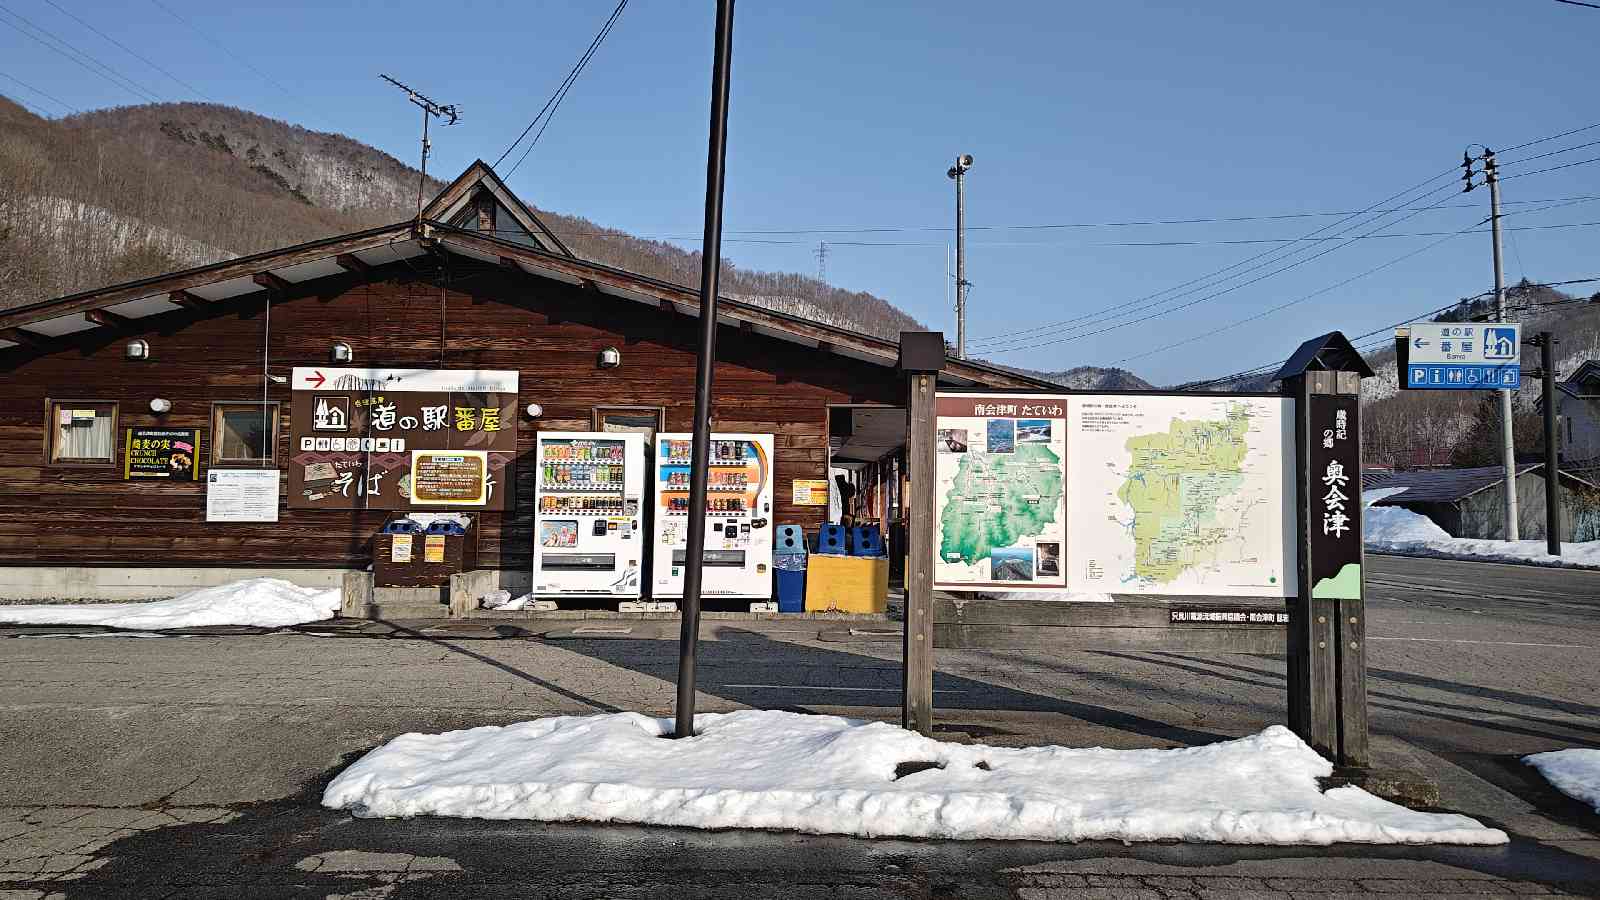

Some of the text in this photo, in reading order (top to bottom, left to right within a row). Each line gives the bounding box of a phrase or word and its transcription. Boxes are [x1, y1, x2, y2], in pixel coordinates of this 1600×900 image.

[1440, 327, 1475, 337] 道の駅
[1441, 341, 1473, 353] 番屋
[974, 404, 1063, 416] 南会津町 たていわ
[130, 449, 157, 457] CRUNCH
[1321, 459, 1351, 539] 奥会津
